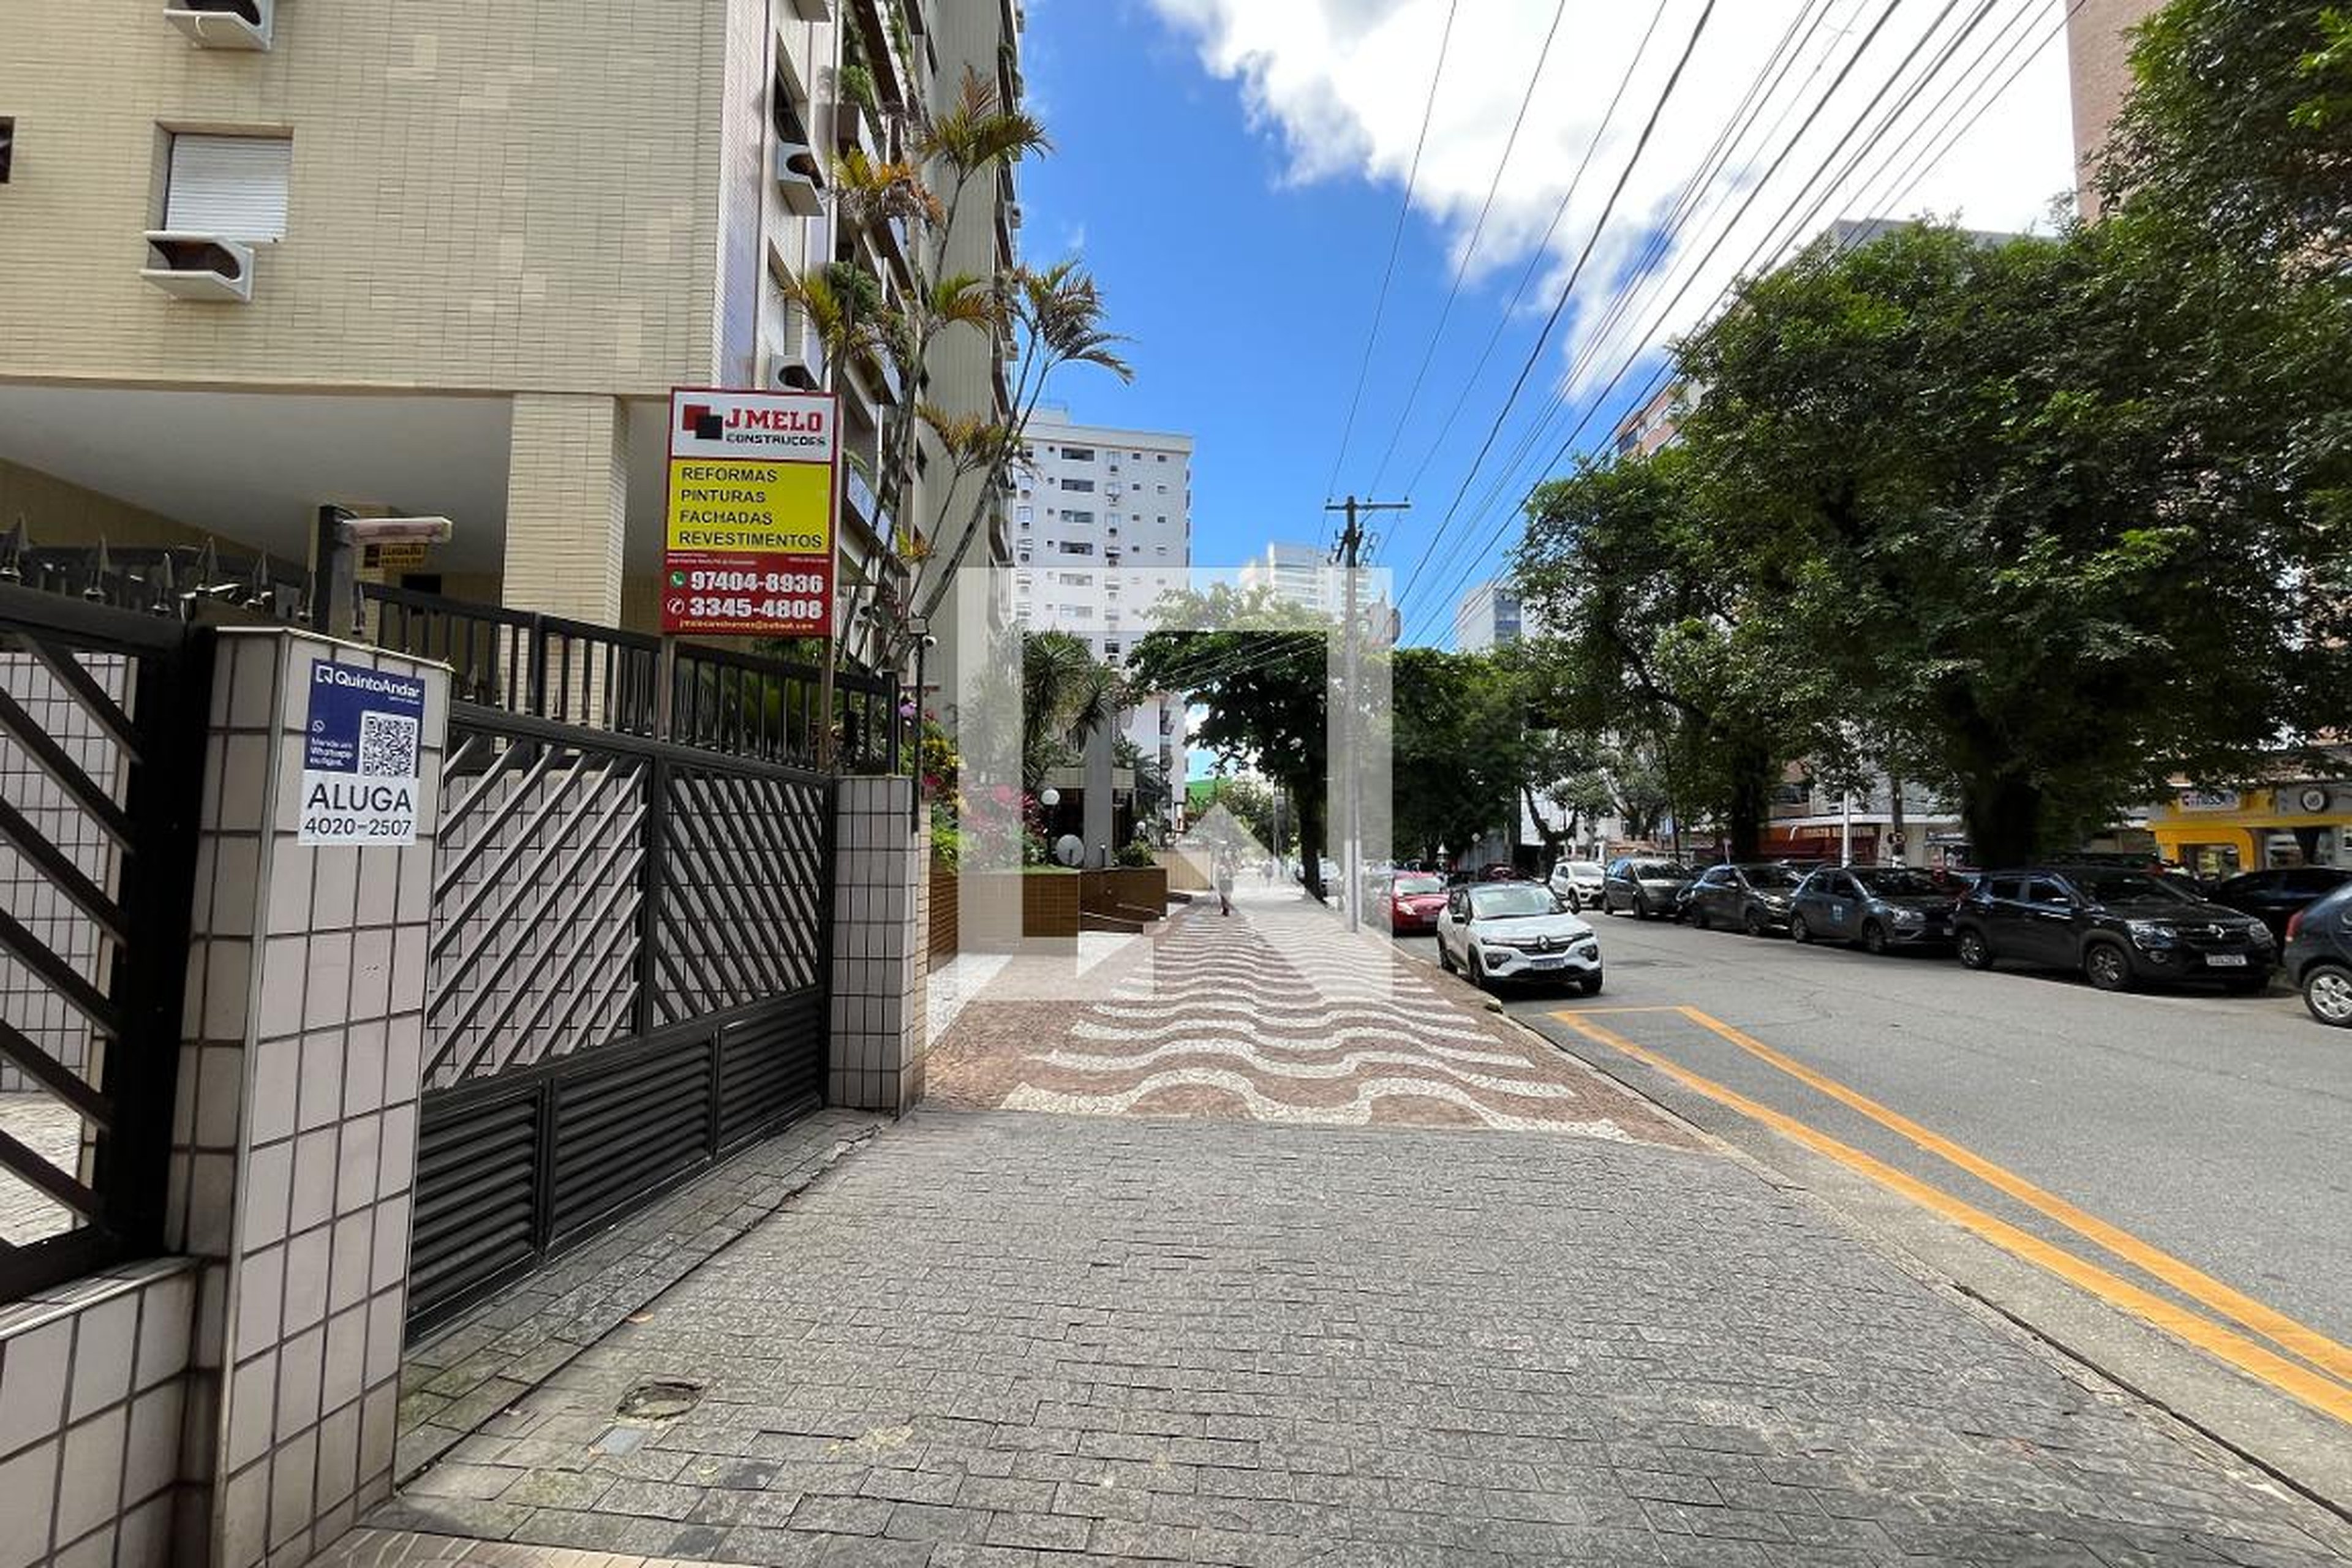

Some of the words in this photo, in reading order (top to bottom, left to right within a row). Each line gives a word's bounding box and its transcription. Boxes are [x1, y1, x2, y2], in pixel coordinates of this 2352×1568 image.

[682, 467, 778, 483] REFORMAS
[680, 489, 766, 503] PINTURAS
[680, 510, 773, 526] FACHADAS
[679, 531, 823, 548] REVESTIMENTOS
[691, 571, 824, 594] 97404-8936
[689, 597, 824, 619] 3345-4808
[335, 671, 421, 697] QuintoAndar
[307, 783, 412, 813] ALUGA
[305, 818, 412, 836] 4020-2507
